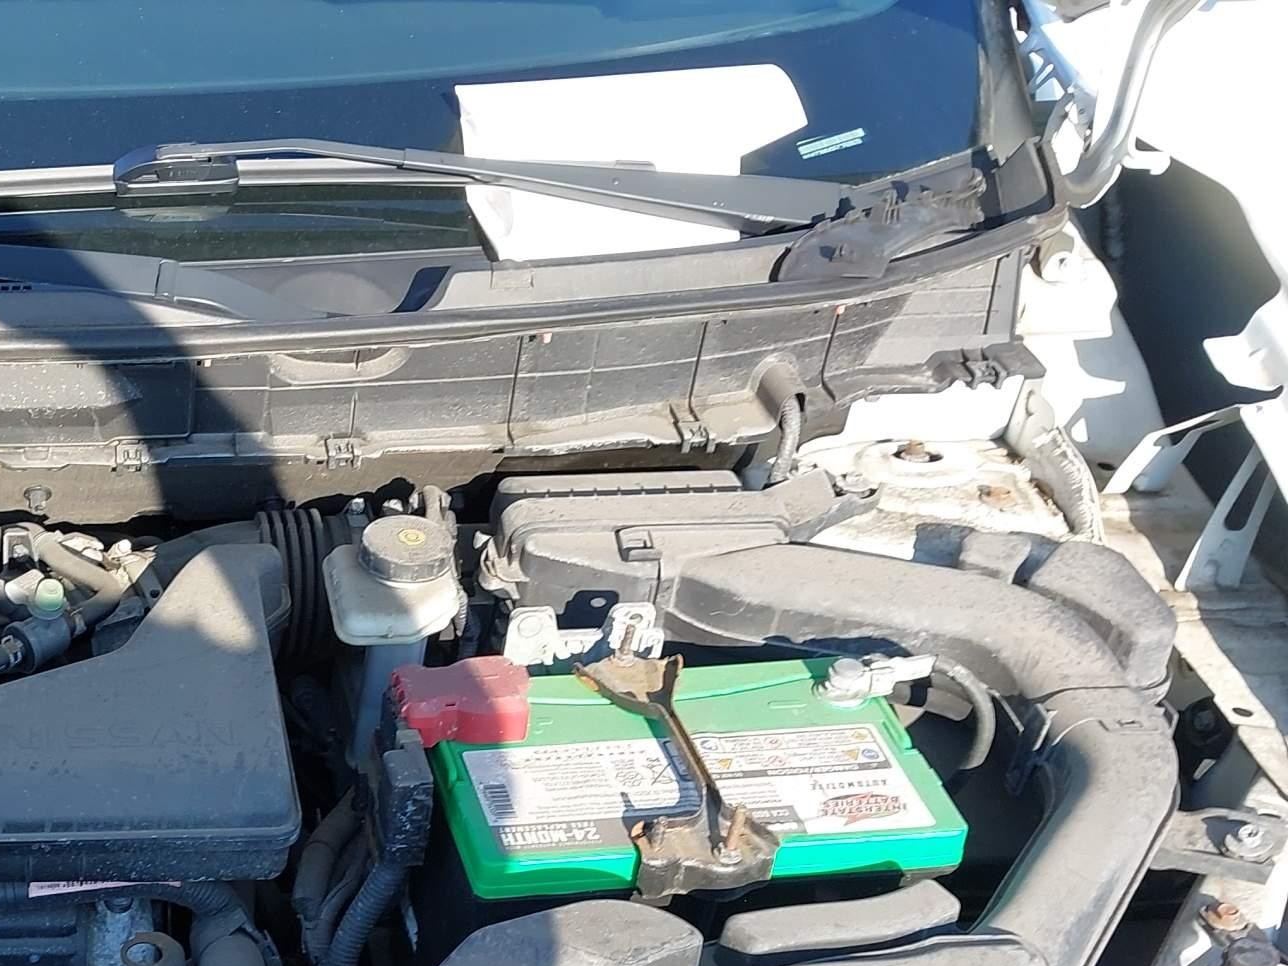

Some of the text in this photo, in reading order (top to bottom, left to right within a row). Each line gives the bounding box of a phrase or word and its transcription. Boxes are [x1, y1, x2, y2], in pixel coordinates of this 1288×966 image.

[810, 778, 888, 791] AUTOMOTIVE
[819, 801, 908, 817] INTERSTATE
[823, 795, 900, 809] BATTERIES
[502, 827, 601, 847] 24-MONTH
